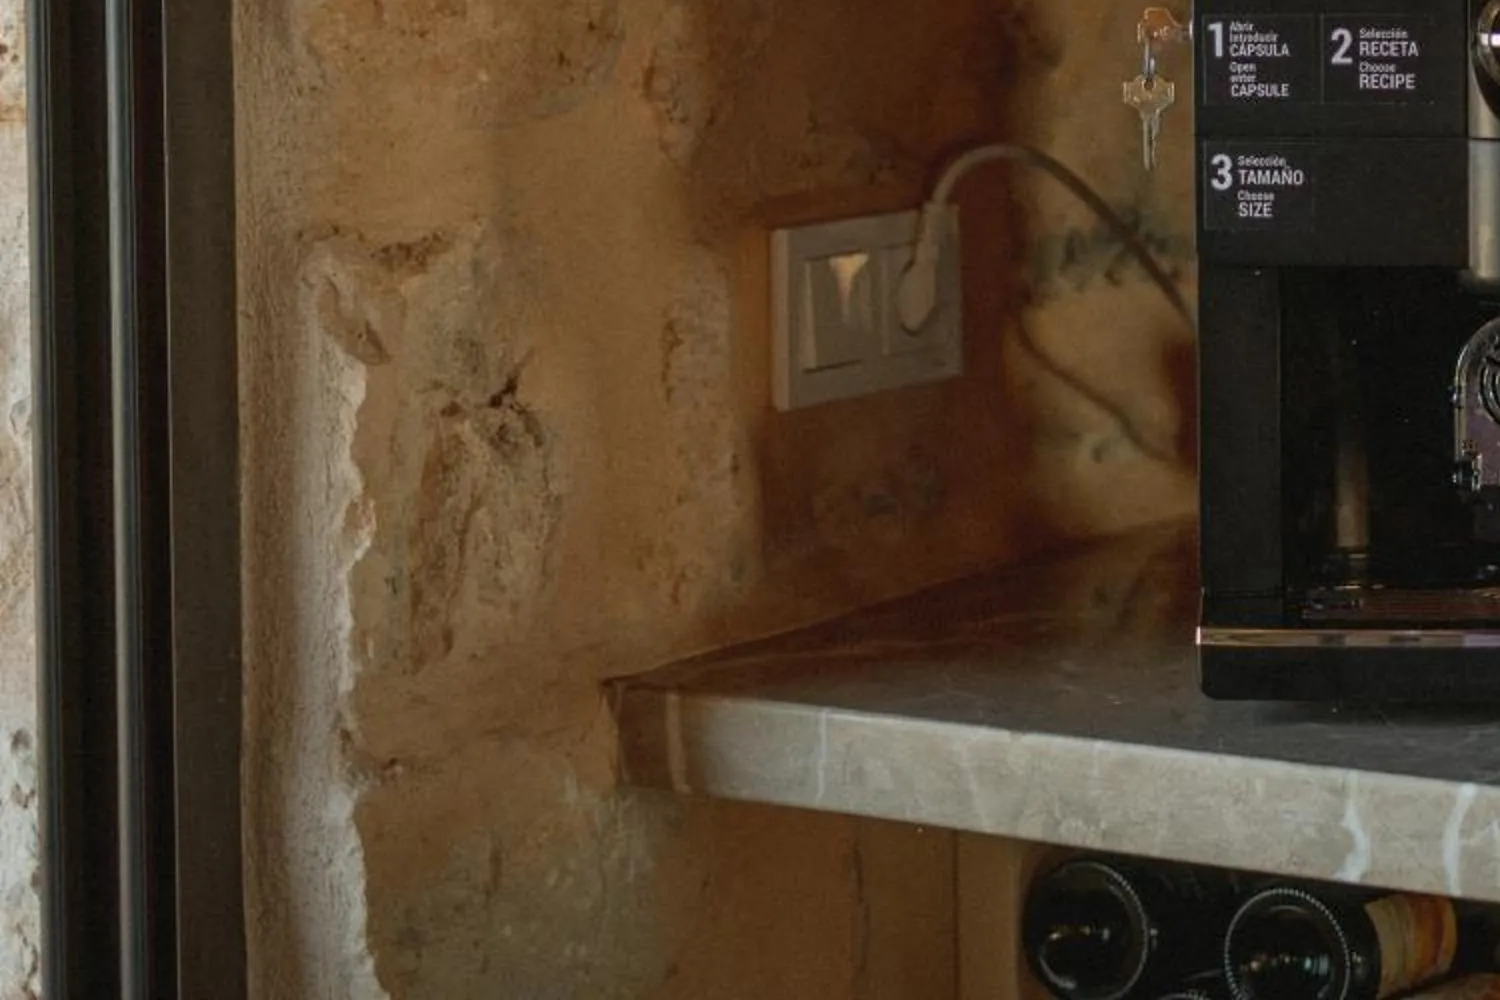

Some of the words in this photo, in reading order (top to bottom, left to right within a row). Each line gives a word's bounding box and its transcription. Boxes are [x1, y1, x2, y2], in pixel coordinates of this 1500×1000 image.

[1229, 21, 1253, 32] Abrir
[1359, 27, 1409, 39] Selección
[1208, 21, 1224, 57] 1
[1331, 27, 1353, 65] 2
[1359, 41, 1419, 57] RECETA
[1229, 62, 1257, 74] Open
[1359, 62, 1396, 73] Choose
[1359, 74, 1416, 89] RECIPE
[1231, 83, 1290, 97] CAPSULE
[1211, 154, 1233, 191] 3
[1238, 165, 1305, 185] TAMAÑO
[1237, 190, 1275, 201] Choose
[1238, 202, 1274, 217] SIZE
